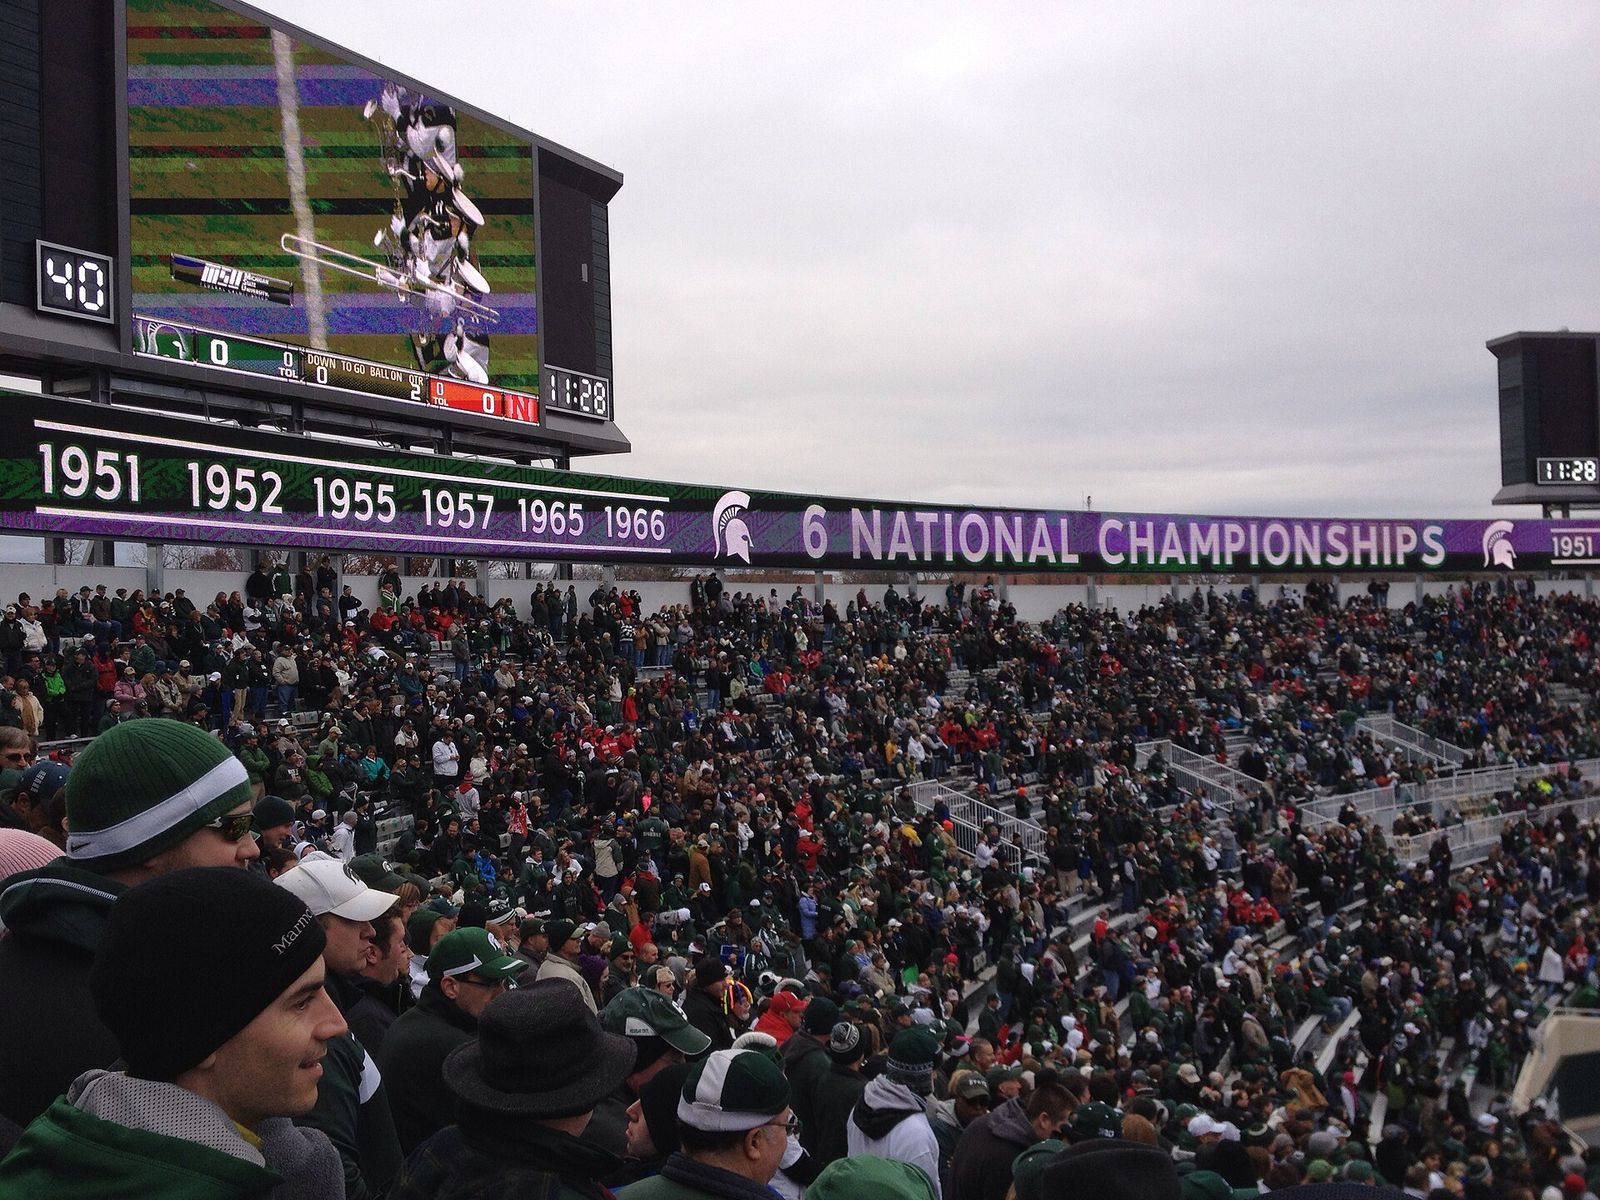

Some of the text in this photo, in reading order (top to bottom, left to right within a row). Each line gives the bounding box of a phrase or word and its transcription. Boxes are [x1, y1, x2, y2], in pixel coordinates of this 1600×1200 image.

[46, 257, 104, 311] 40
[210, 339, 229, 366] 0
[283, 351, 293, 368] 0
[307, 354, 336, 369] DOWN
[277, 367, 299, 378] TOL
[316, 366, 328, 385] 0
[341, 361, 366, 375] TO GO
[370, 366, 403, 383] BALL ON
[408, 375, 424, 387] QTR
[436, 382, 444, 396] 0
[410, 384, 421, 401] 2
[432, 396, 449, 407] TOL
[550, 374, 607, 415] 11:28
[482, 393, 495, 414] 0
[1546, 460, 1597, 482] 11:28
[39, 443, 665, 541] 1951 1952 1955 1957 1965 1966
[803, 504, 1446, 567] 6 NATIONAL CHAMPIONSHIPS
[1552, 535, 1593, 557] 1951
